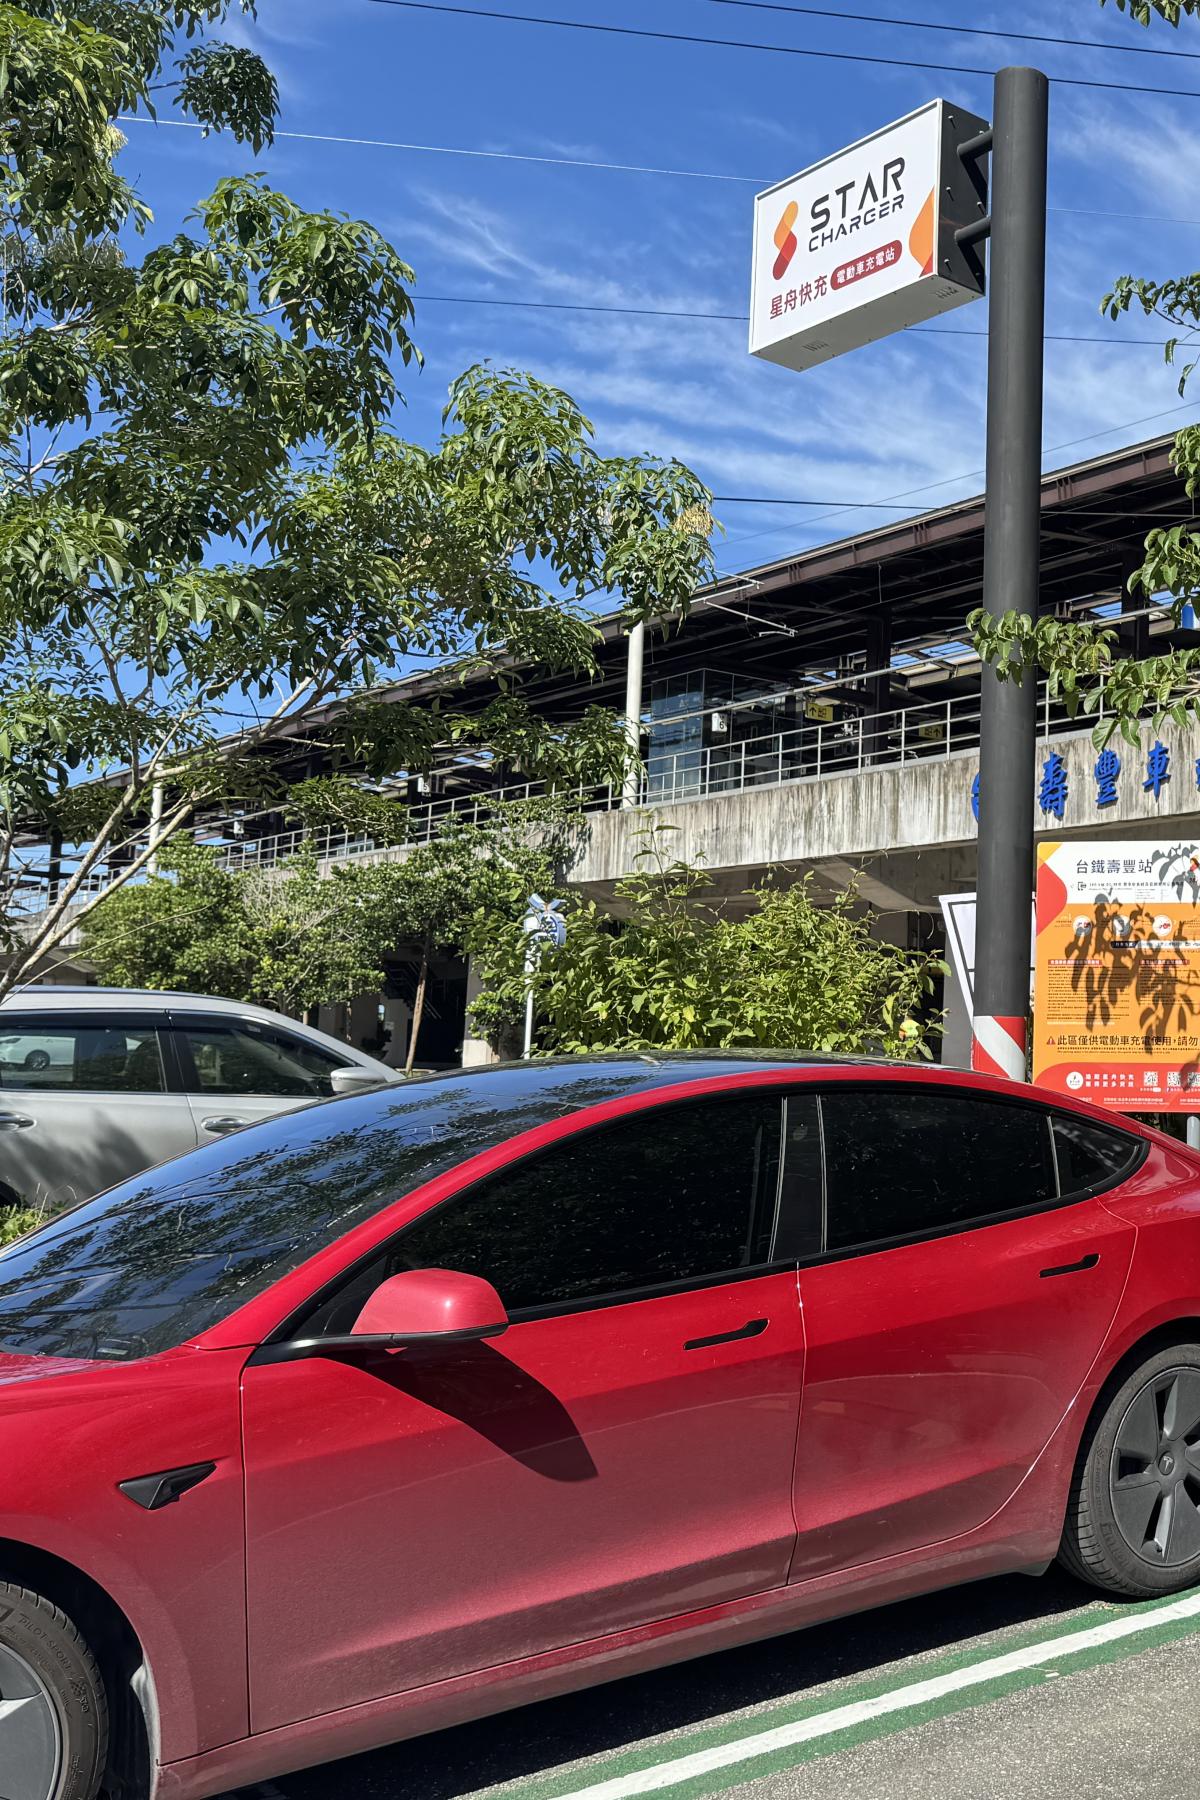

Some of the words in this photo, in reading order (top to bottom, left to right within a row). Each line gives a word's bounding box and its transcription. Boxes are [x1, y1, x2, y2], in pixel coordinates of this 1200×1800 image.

[811, 157, 905, 233] STAR
[809, 194, 904, 252] CHARGER
[837, 247, 895, 283] 電動車充電站
[770, 275, 827, 319] 星舟快充
[719, 720, 725, 730] 6
[1076, 859, 1153, 874] 台鐵壽豐站
